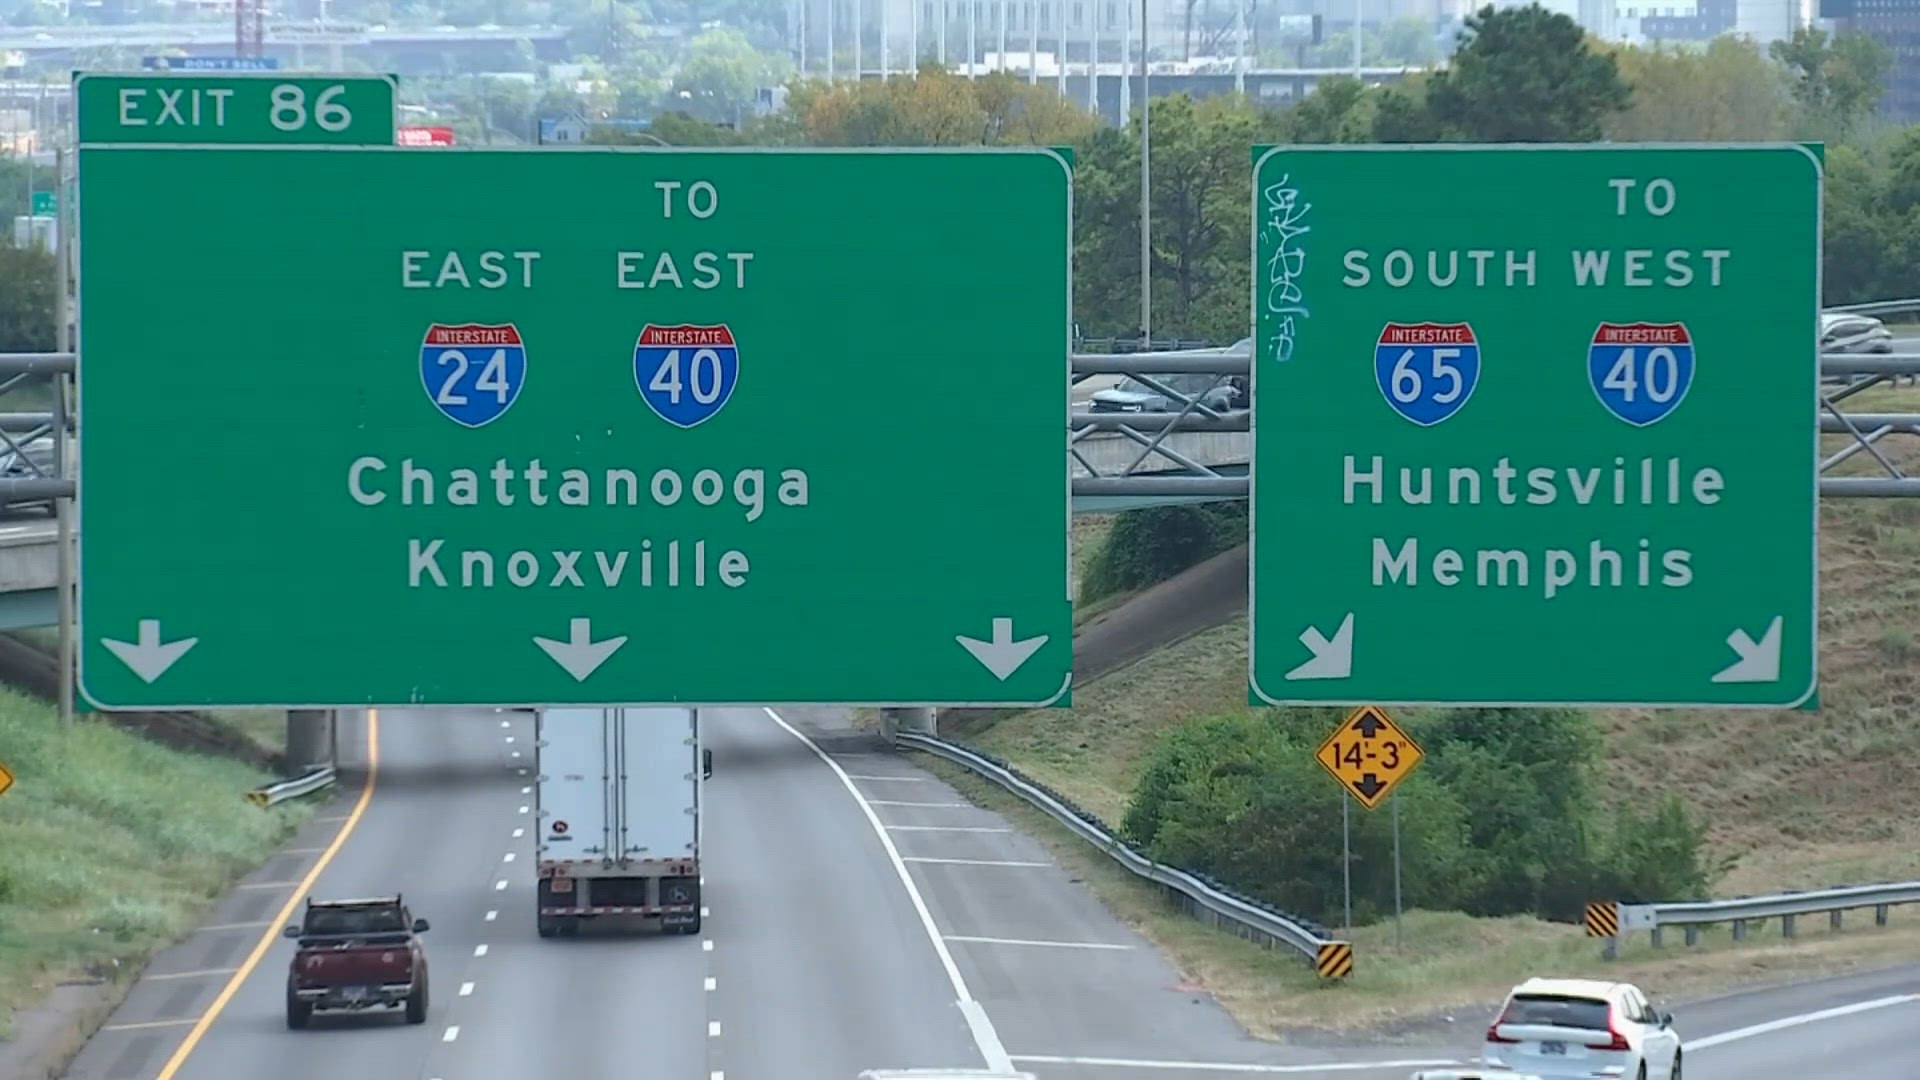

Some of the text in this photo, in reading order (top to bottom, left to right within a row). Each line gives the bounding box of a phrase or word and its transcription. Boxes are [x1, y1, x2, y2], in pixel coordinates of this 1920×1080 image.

[119, 84, 353, 131] EXIT 86
[655, 181, 718, 219] TO
[1608, 179, 1675, 216] TO
[403, 251, 753, 290] EAST EAST
[1343, 250, 1730, 288] SOUTH WEST
[436, 330, 509, 344] INTERSTATE
[650, 330, 721, 344] INTERSTATE
[1391, 328, 1463, 343] INTERSTATE
[1604, 328, 1678, 343] INTERSTATE
[437, 349, 510, 405] 24
[648, 349, 722, 404] 40
[1391, 349, 1463, 403] 65
[1603, 347, 1678, 403] 40
[348, 456, 810, 523] Chattanooga
[1343, 455, 1724, 506] Huntsville
[406, 539, 750, 588] Knoxville
[1372, 537, 1694, 597] Memphis
